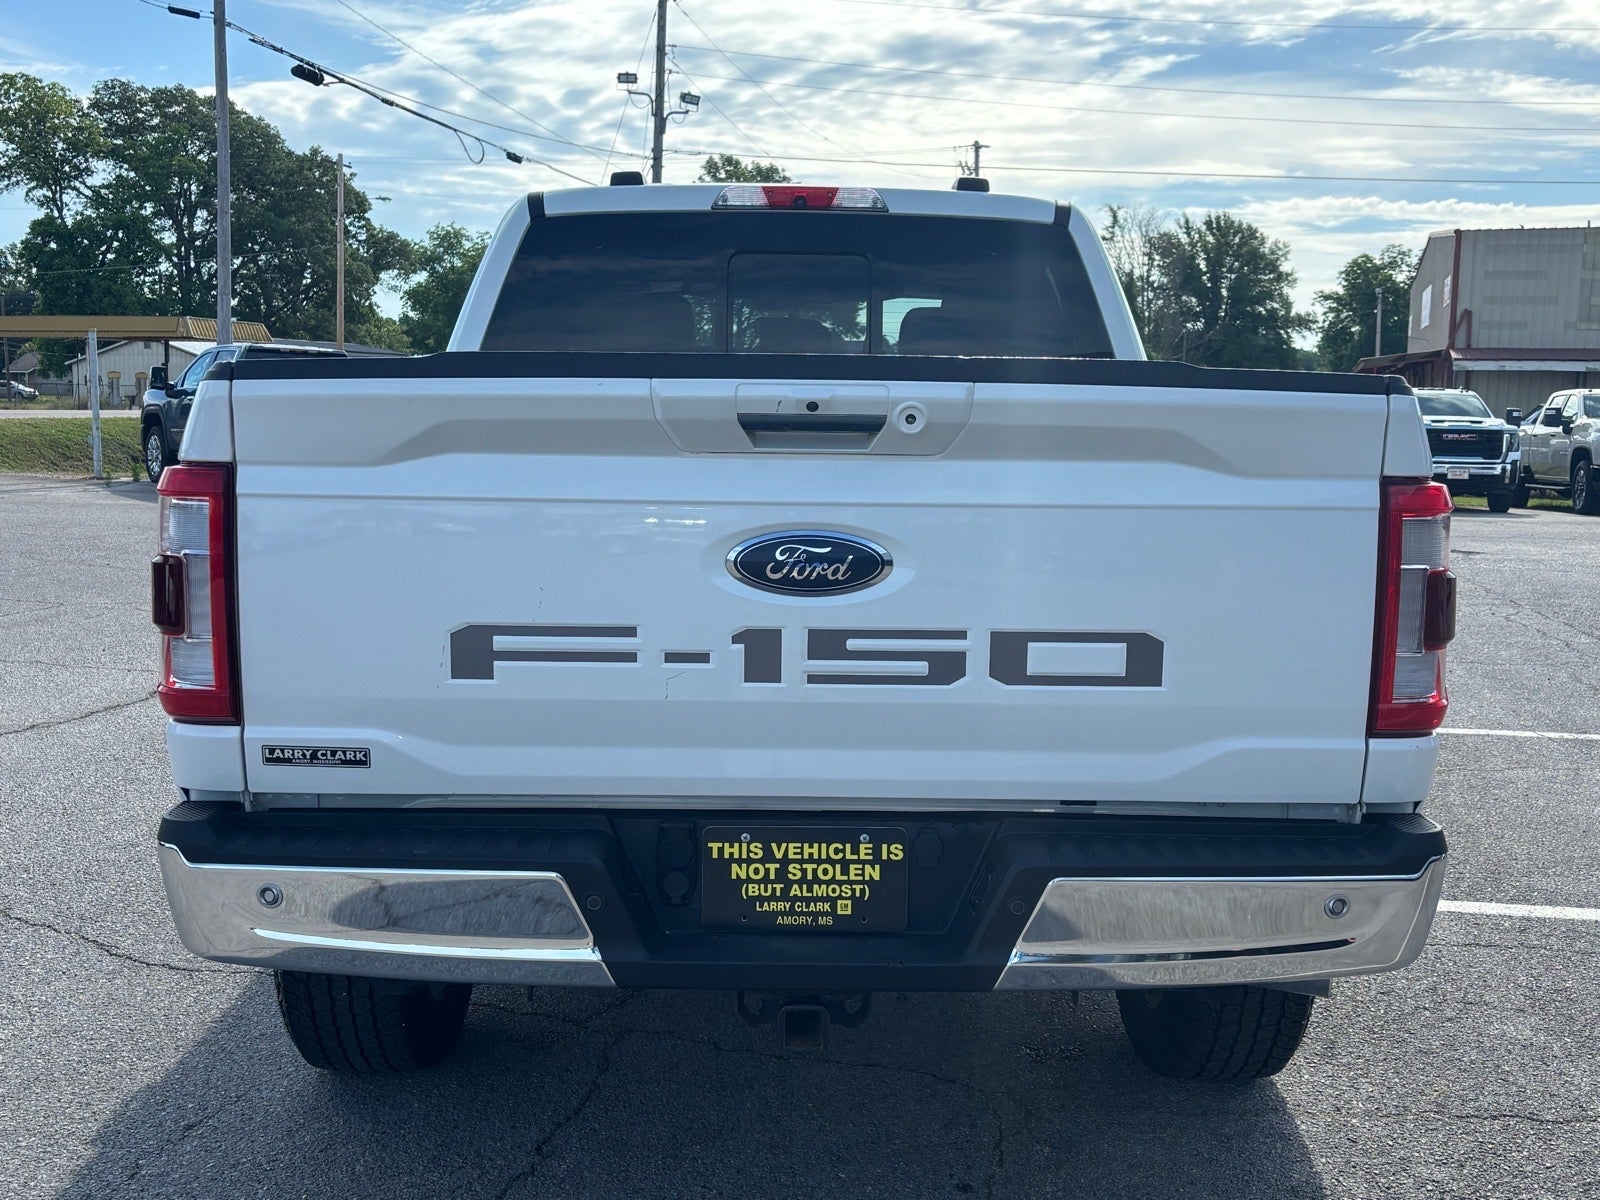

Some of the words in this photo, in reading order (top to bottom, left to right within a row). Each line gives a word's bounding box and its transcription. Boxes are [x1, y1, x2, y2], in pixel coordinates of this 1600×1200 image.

[765, 544, 854, 581] Ford
[449, 622, 1166, 688] F-150
[265, 749, 313, 759] LARRY
[317, 750, 366, 760] CLARK
[707, 842, 764, 859] THIS
[770, 842, 874, 860] VEHICLE
[881, 843, 904, 860] IS
[731, 863, 780, 880] NOT
[787, 863, 881, 881] STOLEN
[741, 883, 785, 900] (BUT
[789, 884, 870, 900] ALMOST)
[756, 901, 791, 912] LARRY
[795, 902, 831, 912] CLARK
[776, 915, 816, 926] AMORY,
[818, 916, 834, 926] MS
